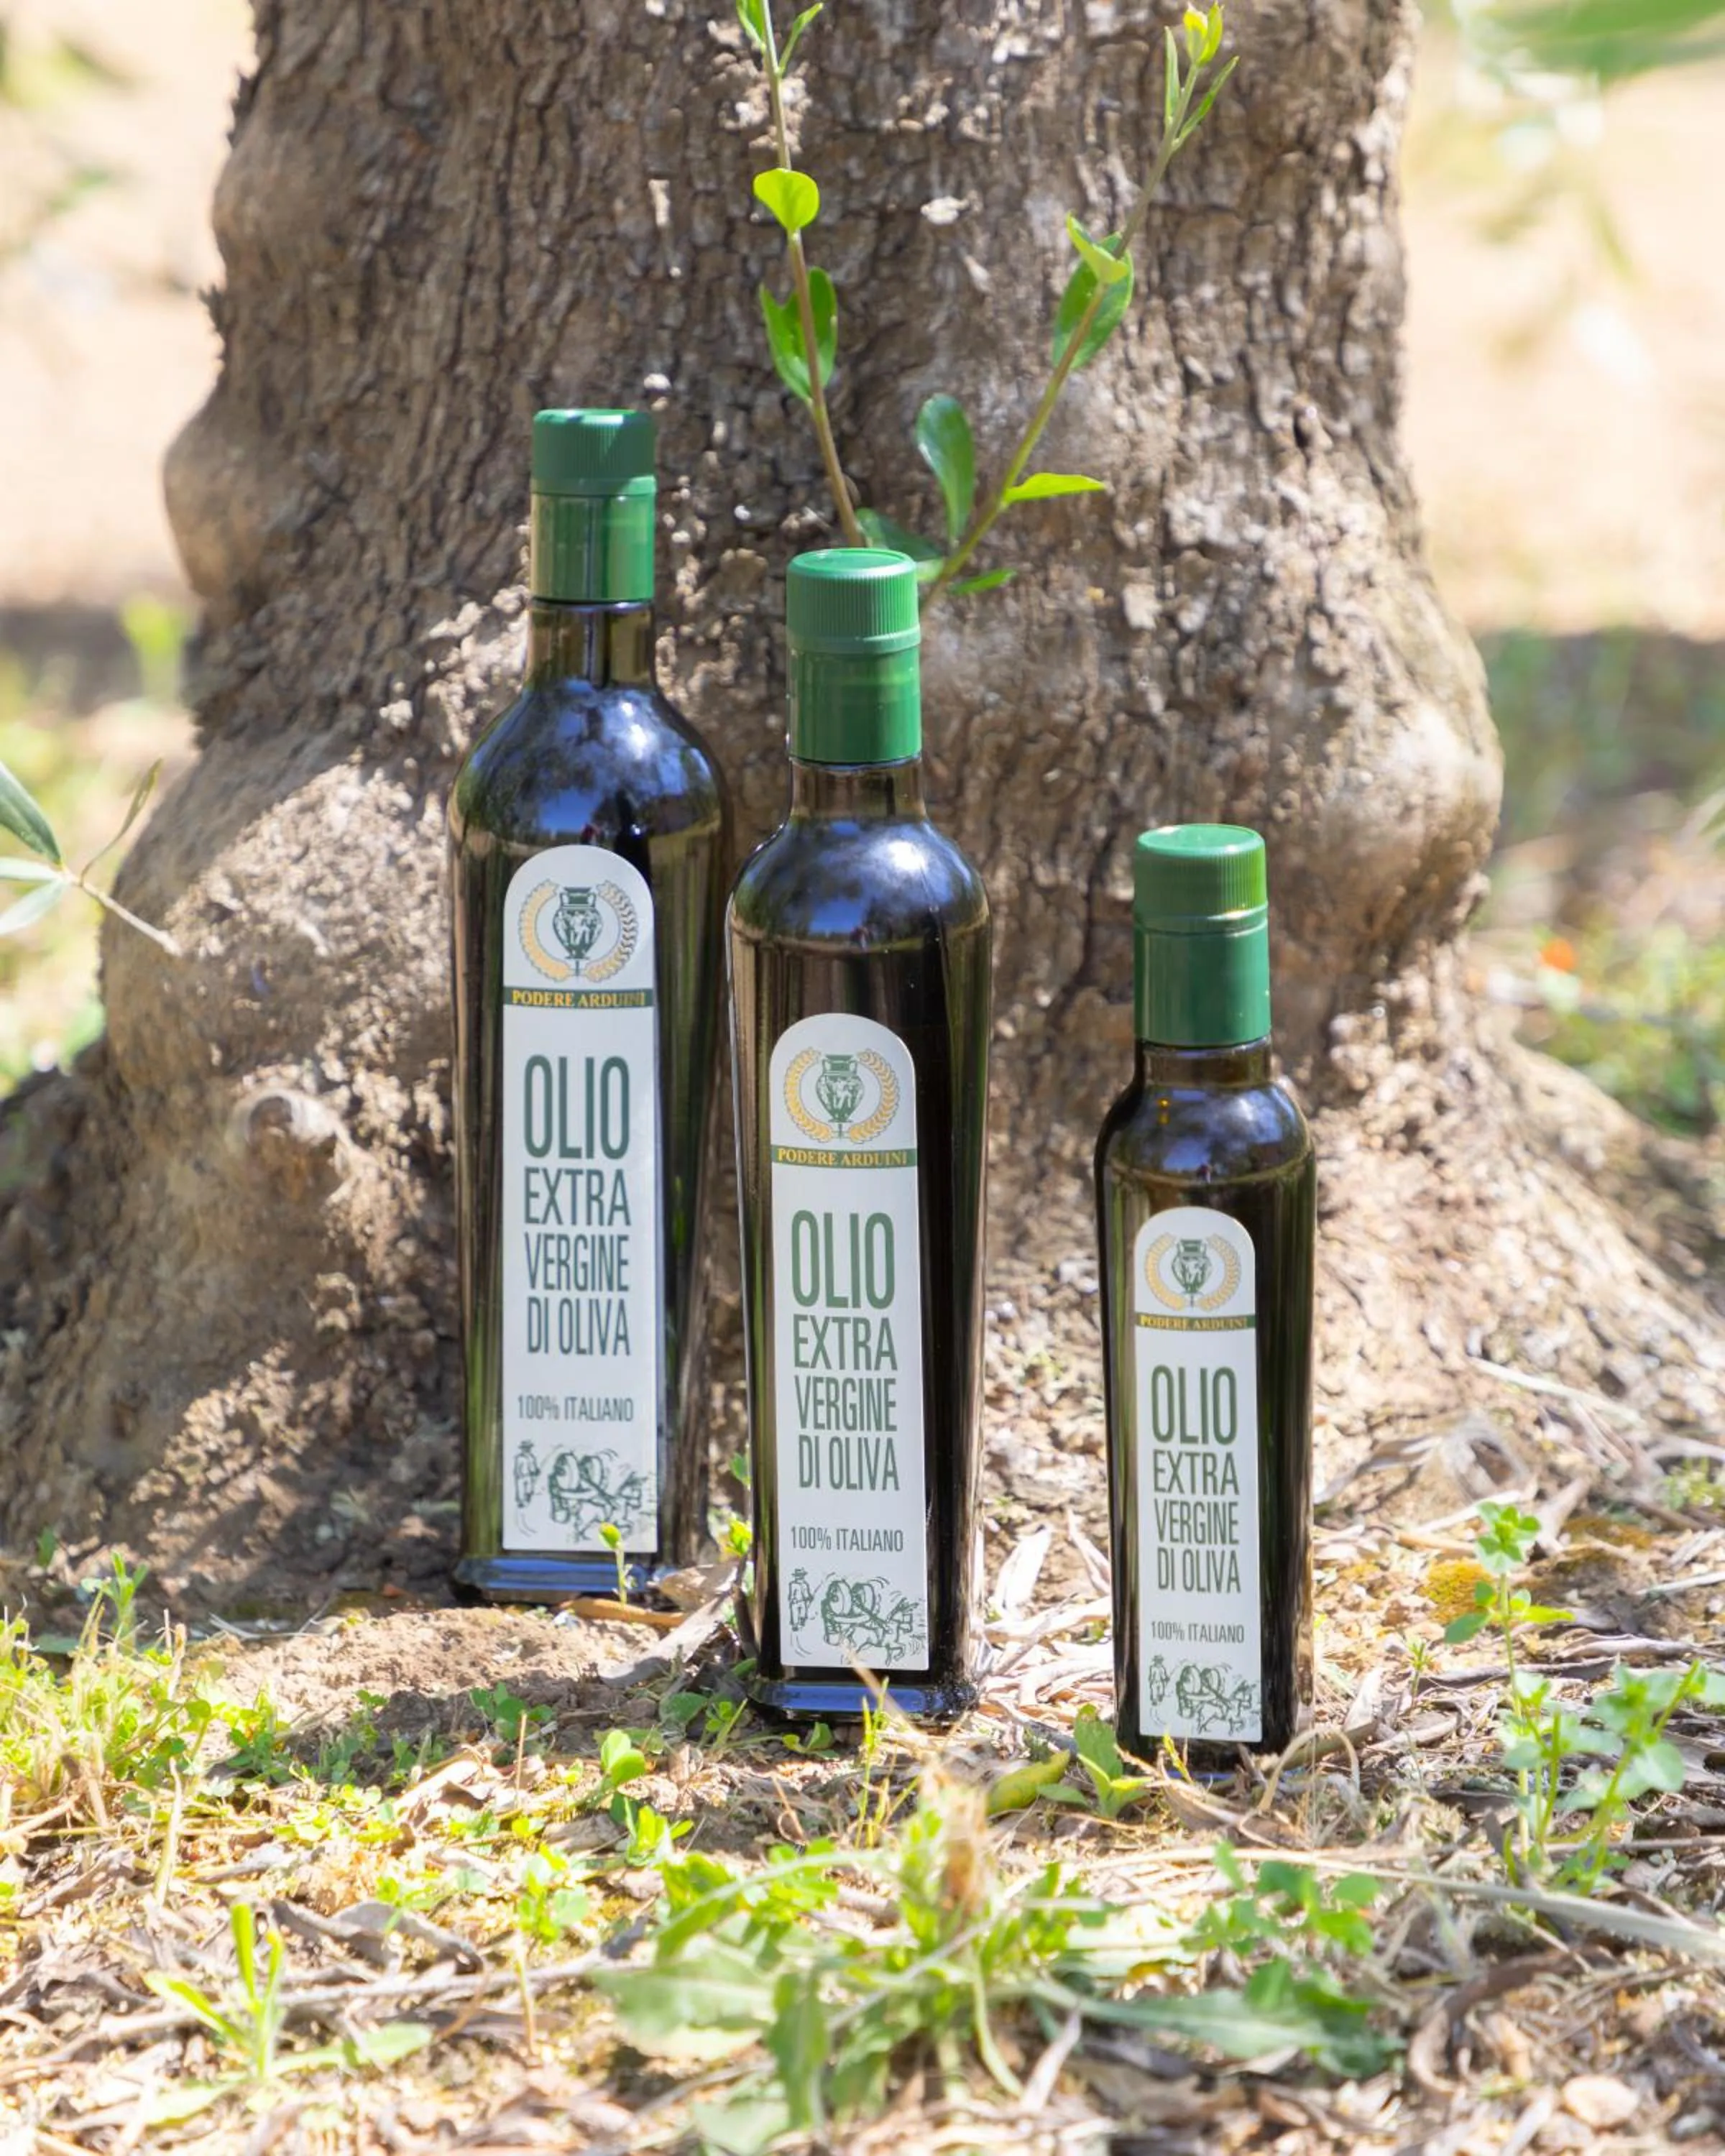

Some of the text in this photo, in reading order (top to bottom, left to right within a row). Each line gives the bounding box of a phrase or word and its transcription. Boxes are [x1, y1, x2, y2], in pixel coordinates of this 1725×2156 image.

[512, 989, 646, 1007] PODERE ARDUINI
[523, 1054, 630, 1160] OLIO
[777, 1148, 907, 1166] PODERE ARDUINI
[524, 1166, 631, 1226] EXTRA
[525, 1233, 630, 1292] VERGINE
[791, 1210, 895, 1309] OLIO
[528, 1296, 631, 1356] DI OLIVA
[794, 1314, 898, 1371] EXTRA
[518, 1395, 633, 1422] 100% ITALIANO
[794, 1375, 897, 1432] VERGINE
[1151, 1365, 1237, 1445] OLIO
[799, 1436, 900, 1491] DI OLIVA
[1153, 1449, 1240, 1496] EXTRA
[791, 1526, 903, 1552] 100% ITALIANO
[1154, 1498, 1240, 1545] VERGINE
[1157, 1548, 1241, 1594] DI OLIVA
[1151, 1621, 1244, 1644] 100% ITALIANO
